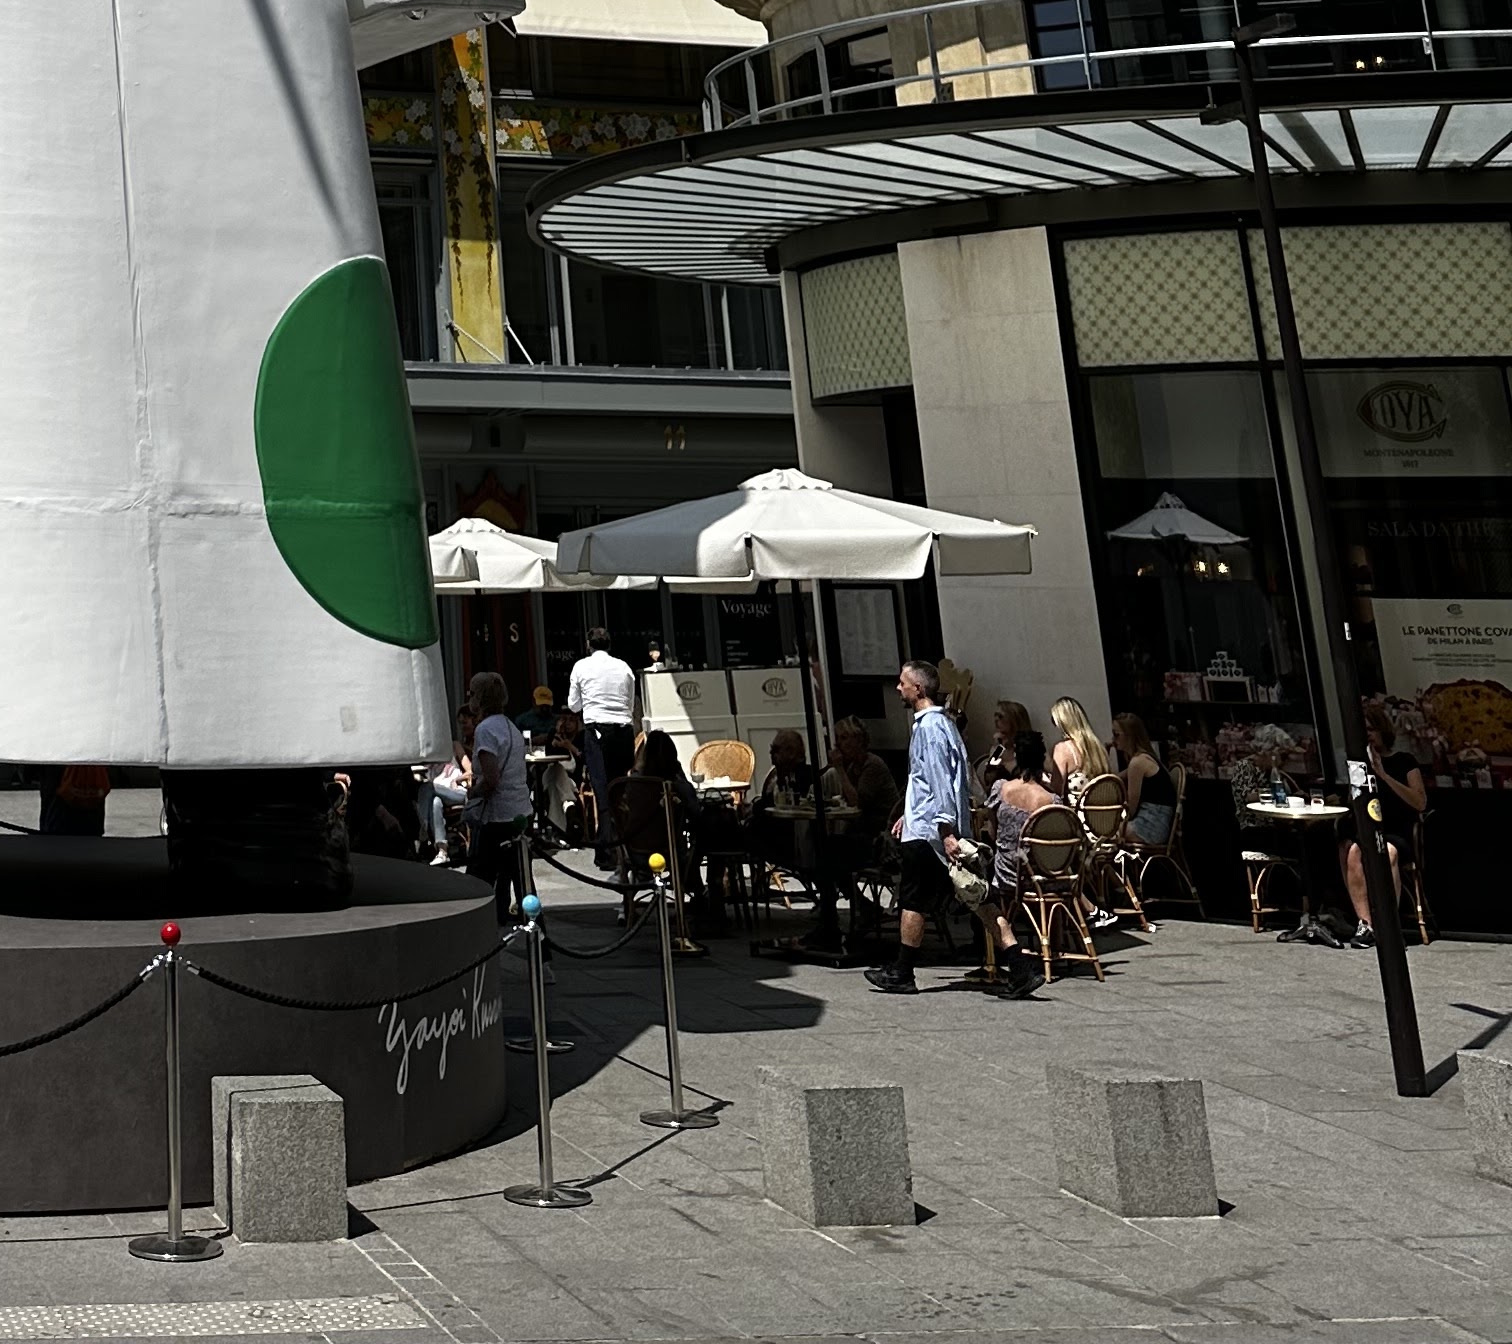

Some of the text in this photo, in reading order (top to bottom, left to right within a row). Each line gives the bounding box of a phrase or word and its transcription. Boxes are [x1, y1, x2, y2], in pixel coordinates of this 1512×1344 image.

[721, 599, 773, 619] Voyage
[1402, 626, 1415, 636] LE
[1418, 626, 1482, 637] PANETTONE
